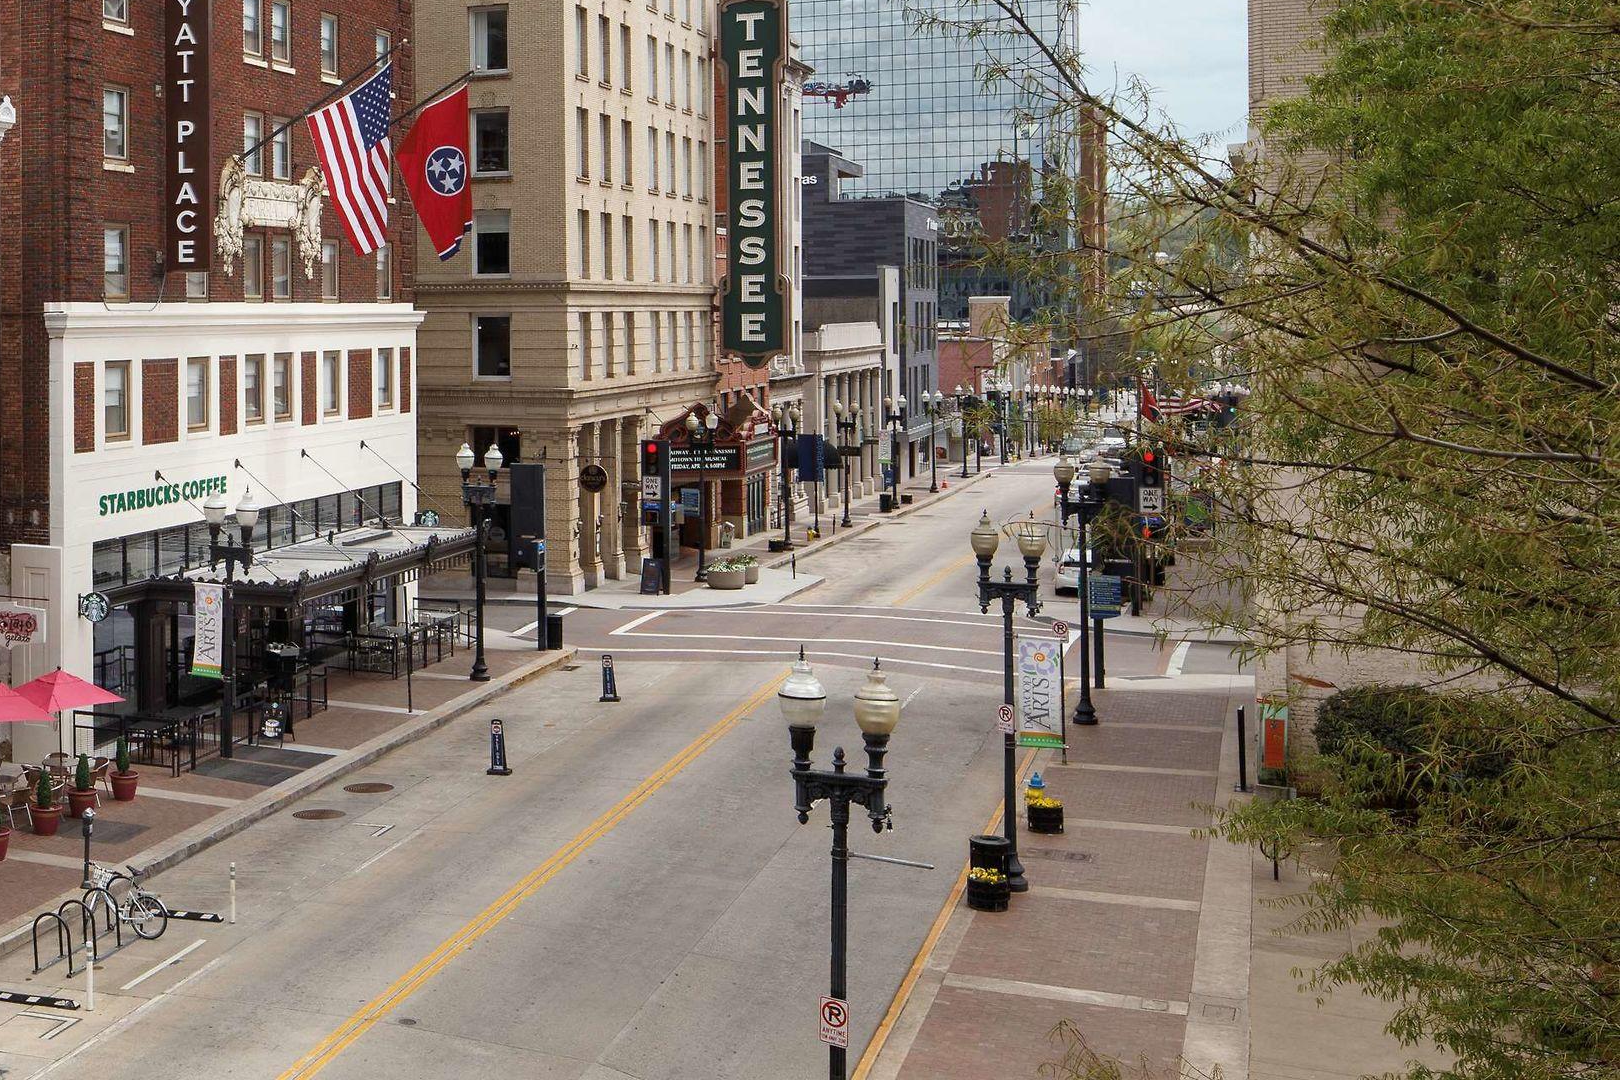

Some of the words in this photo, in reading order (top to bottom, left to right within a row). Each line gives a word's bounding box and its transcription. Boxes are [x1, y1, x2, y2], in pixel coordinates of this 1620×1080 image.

[175, 120, 198, 263] PLACE
[736, 11, 767, 342] TENNESSEE
[99, 483, 180, 517] STARBUCKS
[182, 475, 227, 501] COFFEE
[1143, 495, 1158, 503] WAY
[200, 616, 217, 662] ARTS
[1029, 677, 1051, 730] ARTS
